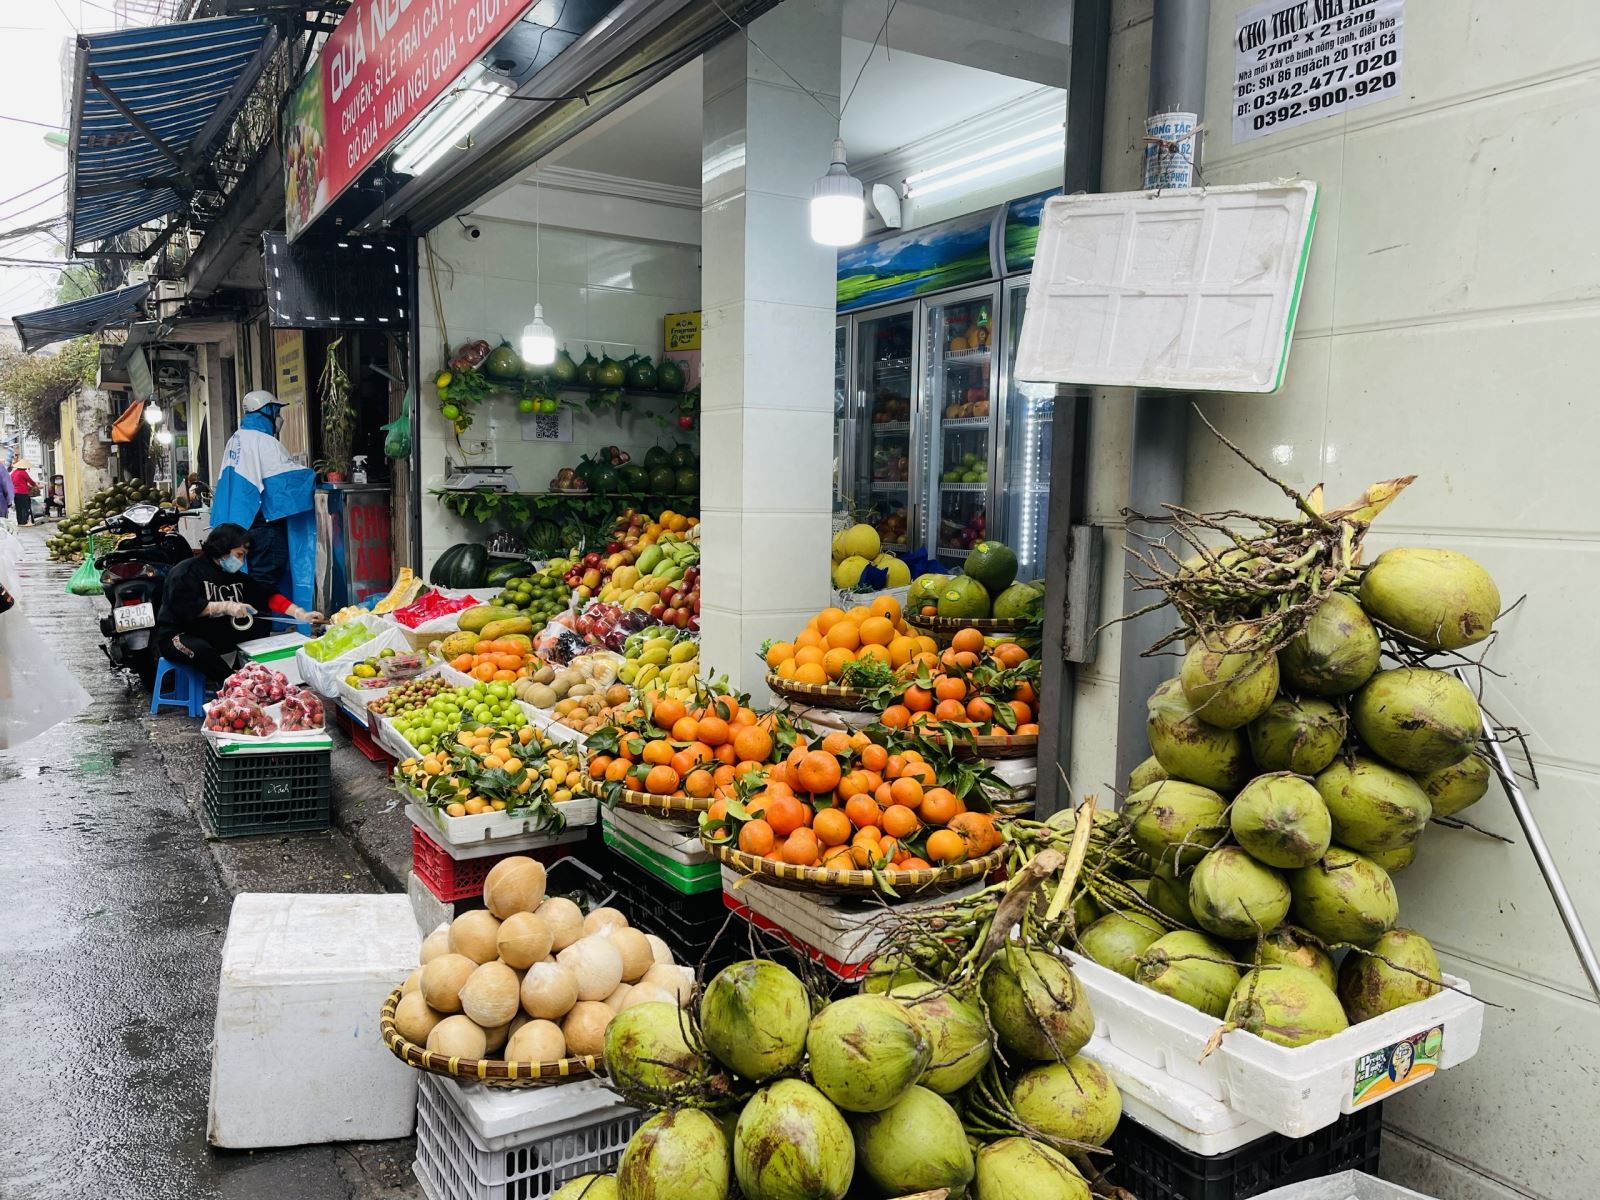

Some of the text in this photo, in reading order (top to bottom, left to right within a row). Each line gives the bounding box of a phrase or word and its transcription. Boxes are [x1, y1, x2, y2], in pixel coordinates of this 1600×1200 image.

[331, 6, 366, 104] QUẢ
[1238, 19, 1267, 53] CHO
[1305, 31, 1314, 43] x
[1321, 24, 1331, 37] 2
[1337, 9, 1375, 31] tầng
[342, 80, 374, 135] CHUYÊN:
[398, 14, 420, 68] TRÁI
[348, 127, 361, 168] GIỎ
[362, 105, 378, 154] QUẢ
[432, 17, 456, 80] QUẢ
[1237, 50, 1397, 116] ĐT: 0342.477.020
[1238, 31, 1396, 97] ĐC: SN 86 ngách 20 Trại Cá
[1238, 68, 1253, 82] Nhà
[1253, 71, 1396, 130] 0392.900.920
